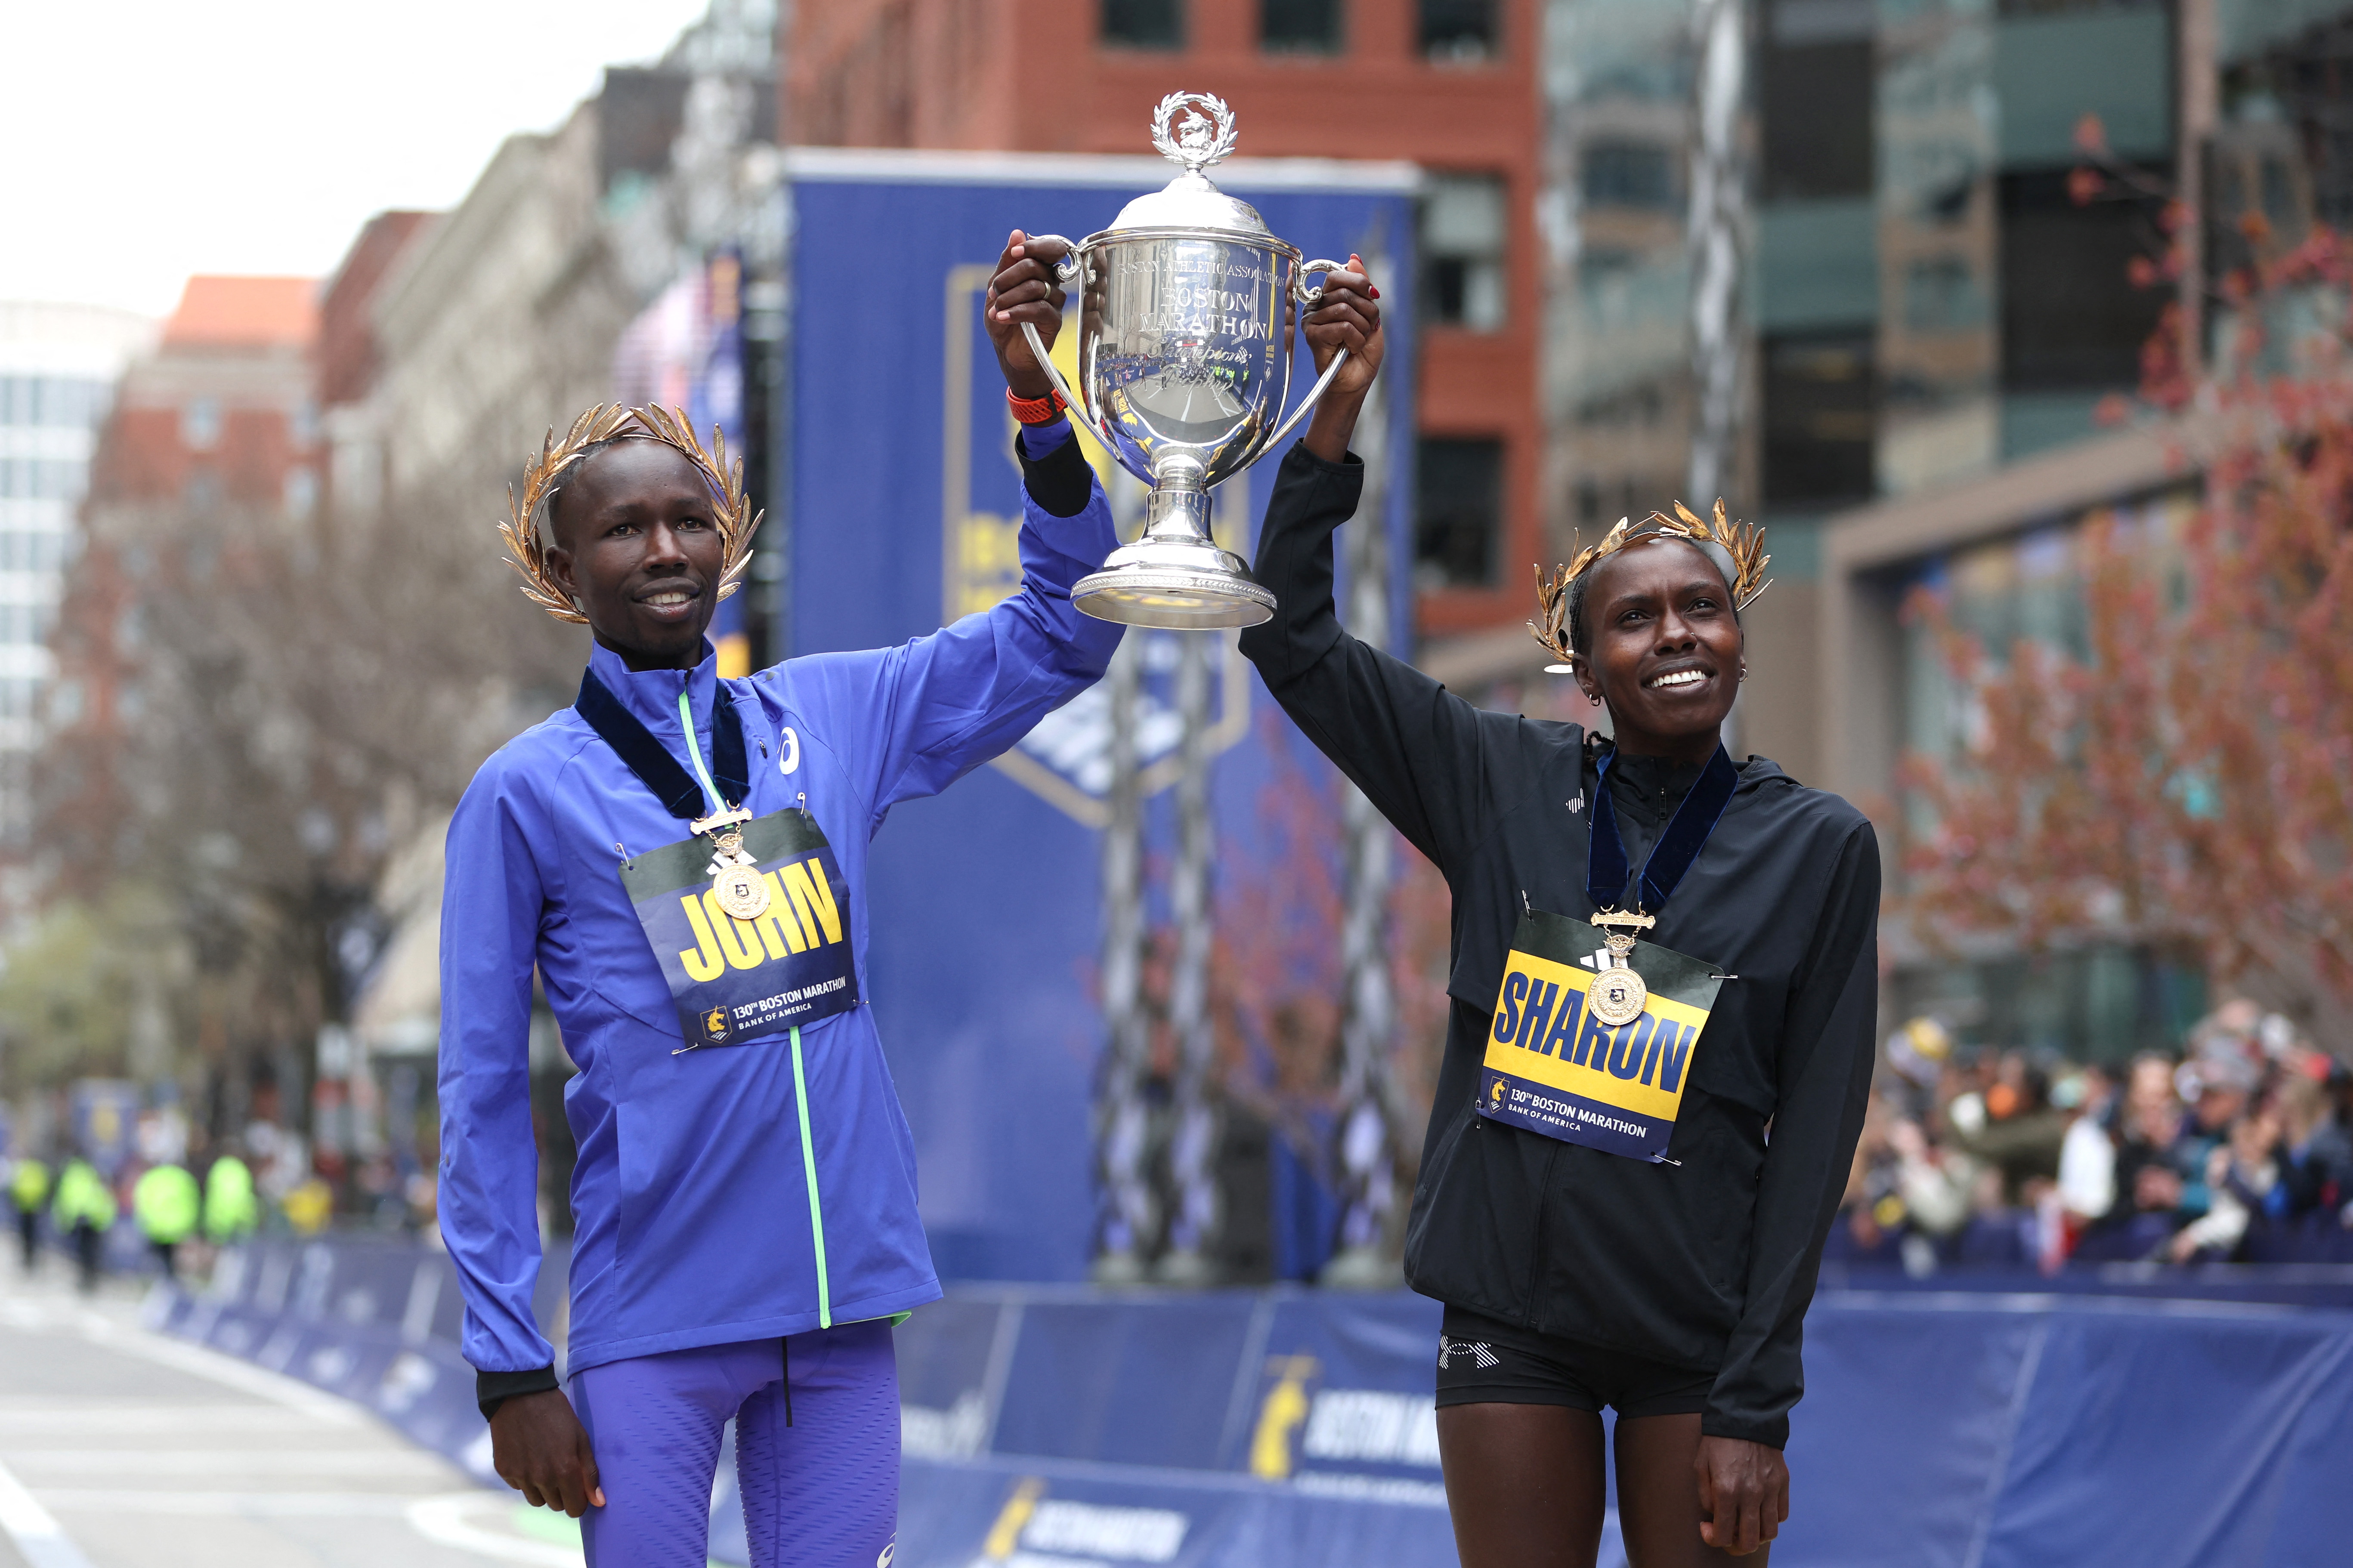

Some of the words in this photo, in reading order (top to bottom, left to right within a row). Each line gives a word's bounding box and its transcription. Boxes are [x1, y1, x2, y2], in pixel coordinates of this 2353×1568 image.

[1117, 261, 1160, 275] BOSTON
[1163, 260, 1223, 274] ATHLETIC
[1227, 264, 1286, 287] ASSOCIATION
[1160, 287, 1249, 313] BOSTON
[1138, 312, 1267, 342] MARATHON
[679, 857, 843, 982] JOHN
[733, 1002, 758, 1019] 130TH
[758, 989, 802, 1012] BOSTON
[802, 975, 846, 999] MARATHON
[738, 1016, 764, 1030] BANK
[765, 1012, 777, 1022] OF
[779, 1003, 812, 1018] AMERICA
[1493, 971, 1696, 1094] SHARON
[1508, 1103, 1529, 1116] BANK
[1530, 1110, 1541, 1119] OF
[1541, 1114, 1581, 1132] AMERICA
[1510, 1088, 1533, 1103] 130TH
[1531, 1095, 1576, 1118] BOSTON
[1577, 1109, 1648, 1138] MARATHON
